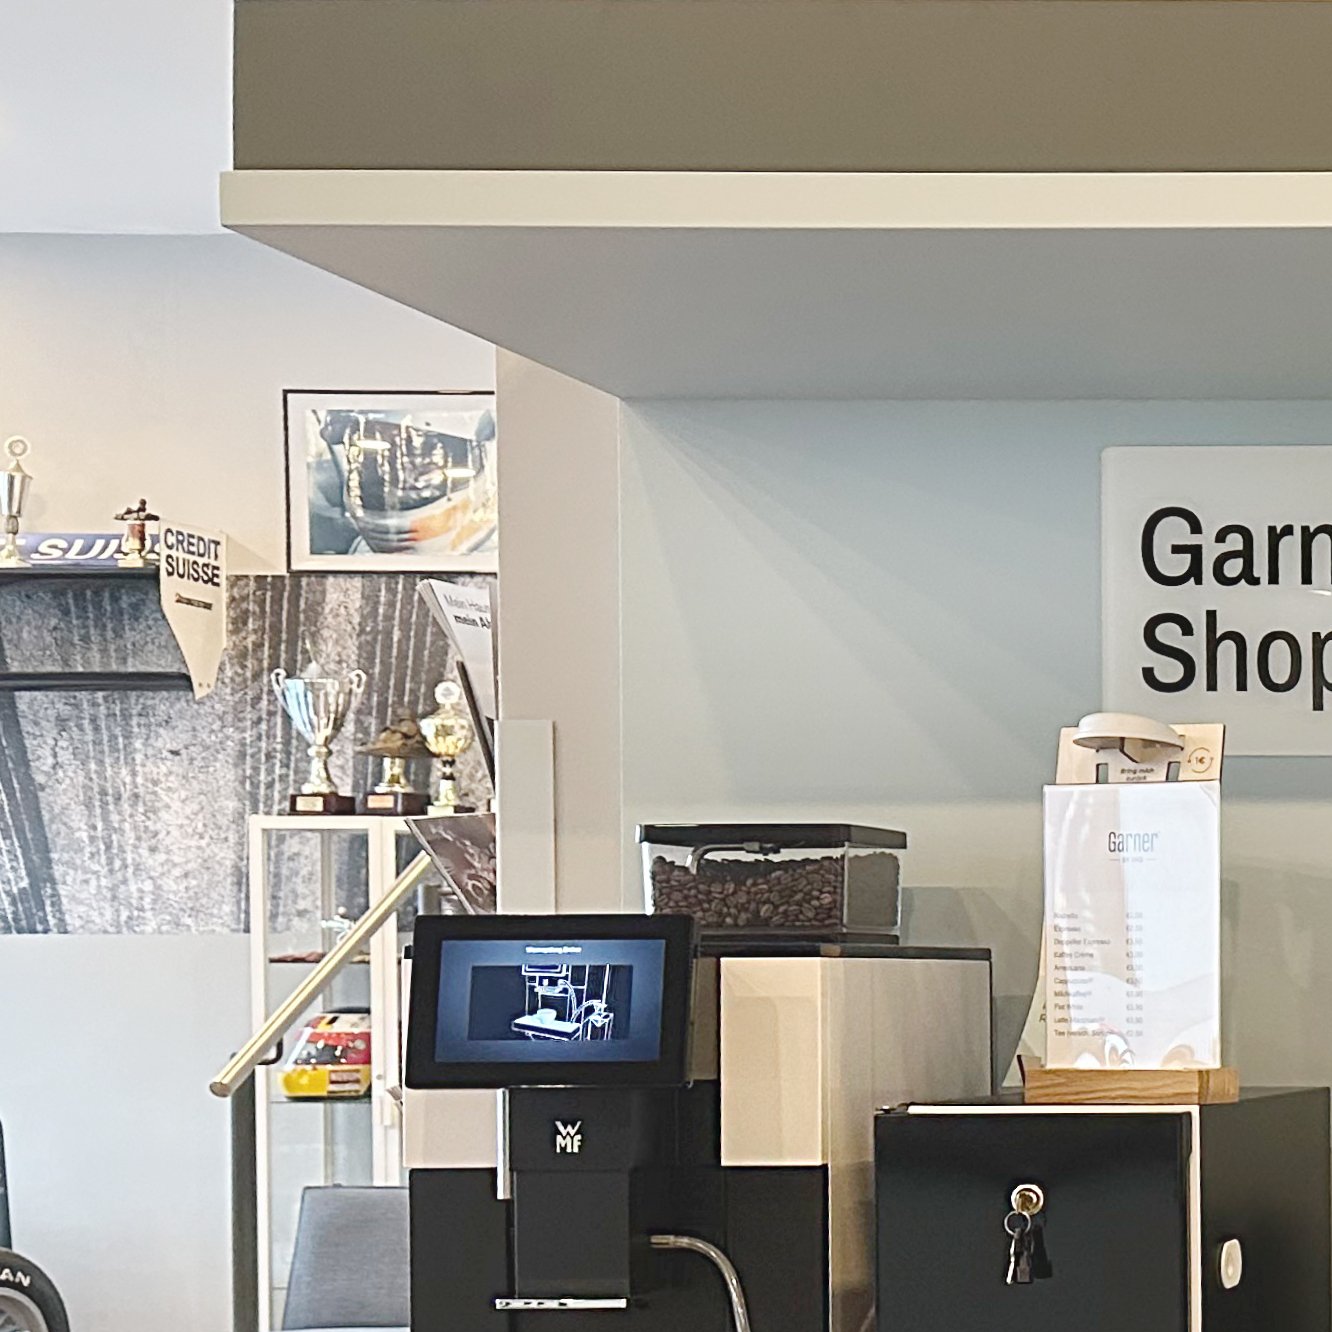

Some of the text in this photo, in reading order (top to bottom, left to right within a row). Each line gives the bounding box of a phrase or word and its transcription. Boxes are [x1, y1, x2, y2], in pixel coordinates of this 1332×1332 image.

[164, 528, 220, 561] CREDIT
[165, 554, 220, 587] SUISSE
[1108, 831, 1159, 853] Garner
